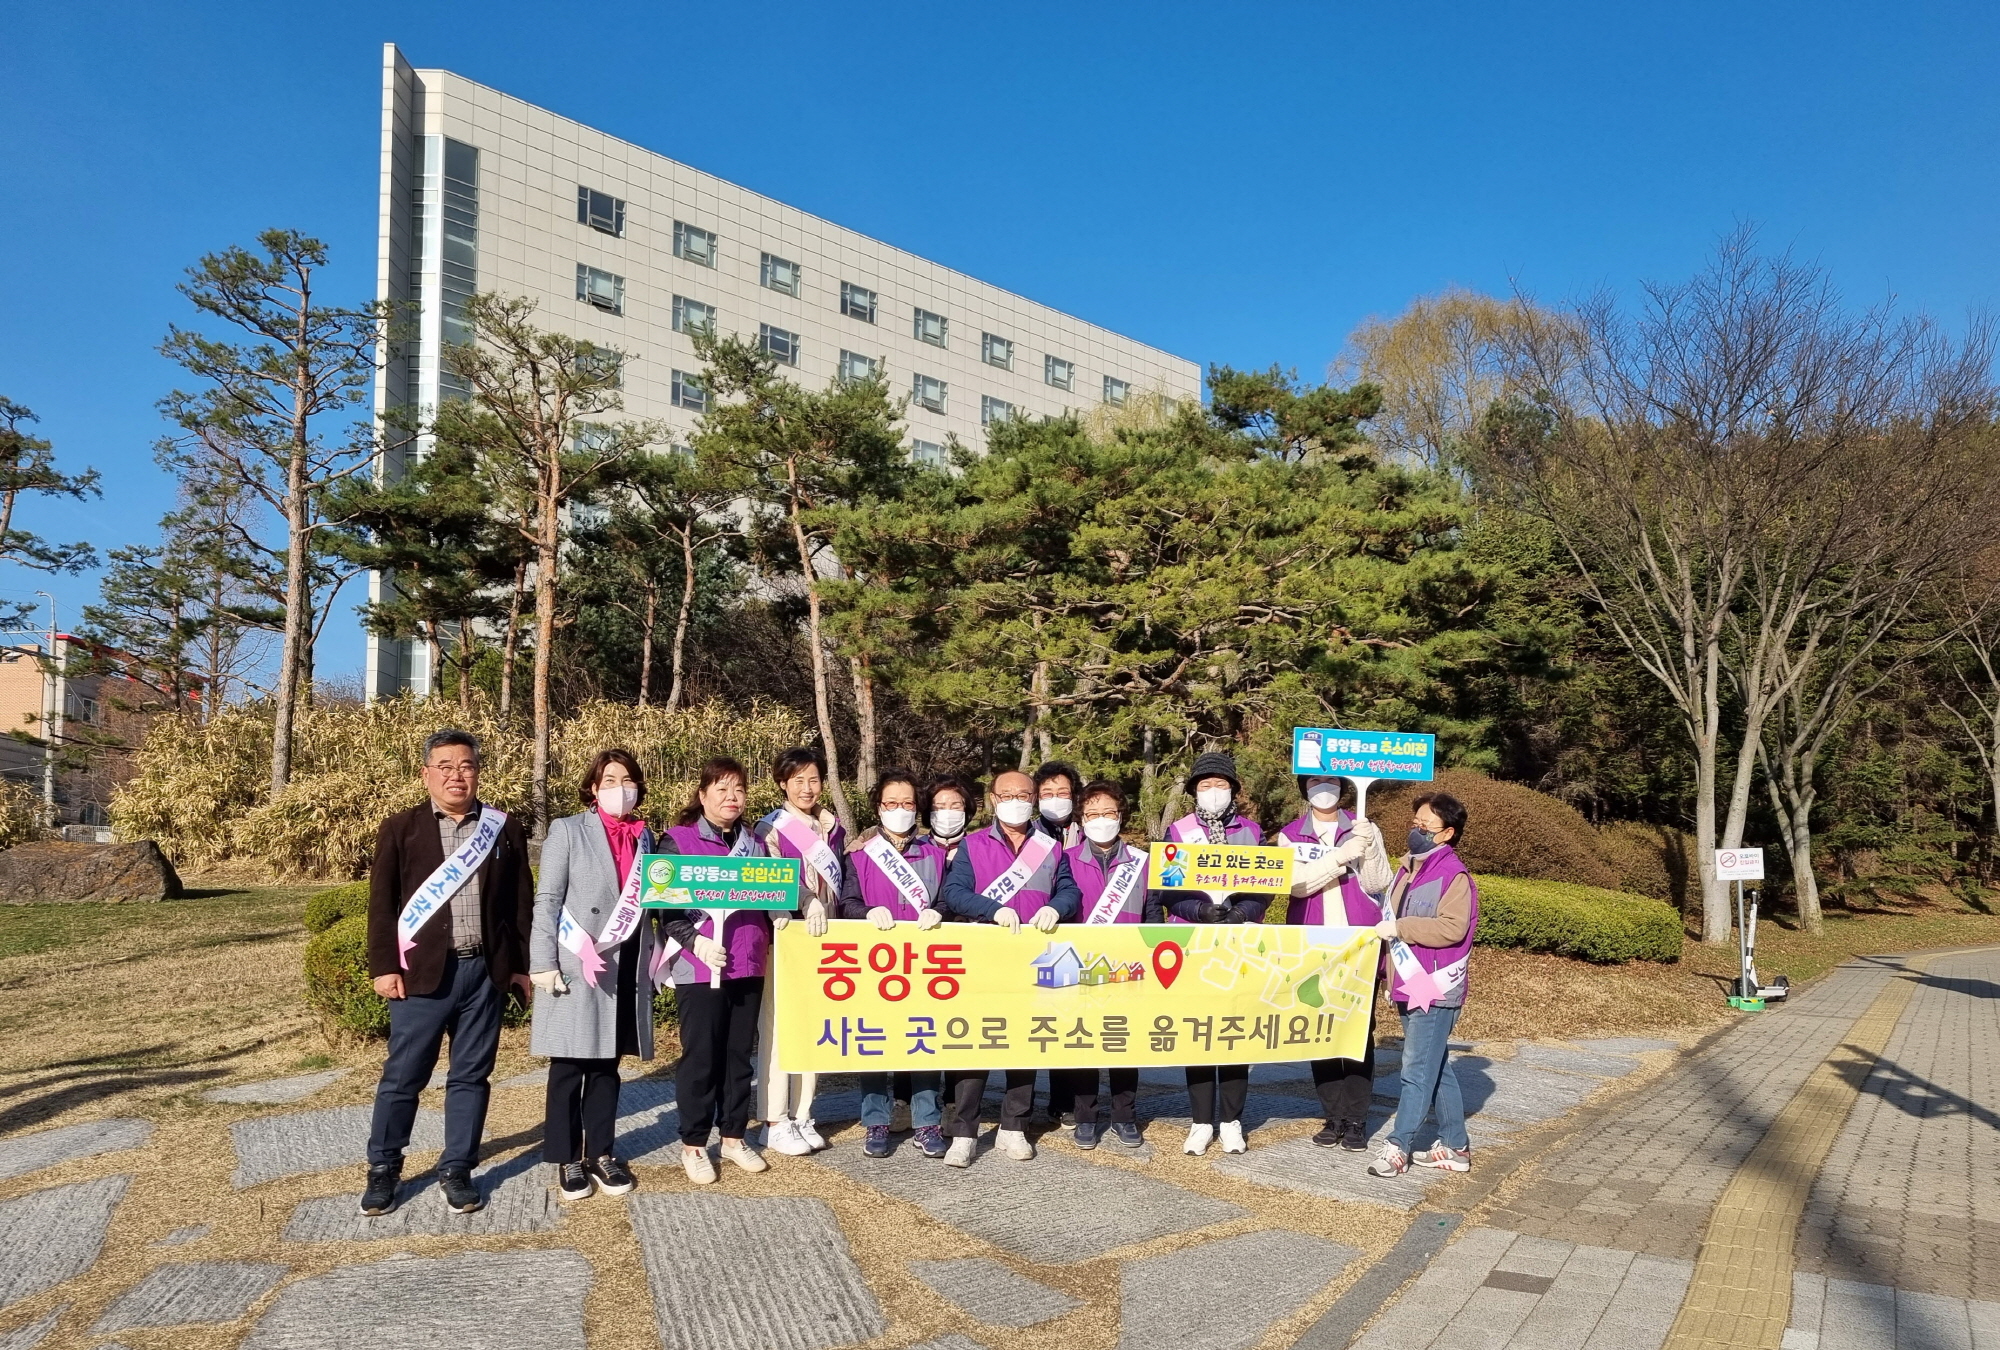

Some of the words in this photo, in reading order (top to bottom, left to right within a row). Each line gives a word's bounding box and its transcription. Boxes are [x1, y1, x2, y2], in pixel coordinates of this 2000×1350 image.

[1326, 738, 1378, 754] 중앙동으로
[1380, 740, 1428, 757] 주소이전
[1331, 757, 1364, 771] 중앙동이
[1367, 759, 1422, 773] 행복합니다!!
[1196, 854, 1222, 868] 살고
[1226, 854, 1251, 869] 있는
[1254, 855, 1284, 870] 곳으로
[680, 865, 738, 882] 중앙동으로
[741, 866, 795, 884] 전입신고
[1195, 873, 1228, 887] 주소지를
[1232, 874, 1284, 887] 옮겨주세요!!
[694, 889, 725, 902] 당신이
[729, 889, 786, 902] 최고입니다!!
[817, 942, 966, 1002] 중앙동
[817, 1016, 887, 1057] 사는
[905, 1016, 1010, 1055] 곳으로
[1028, 1015, 1131, 1053] 주소를
[1148, 1013, 1335, 1053] 옮겨주세요!!
